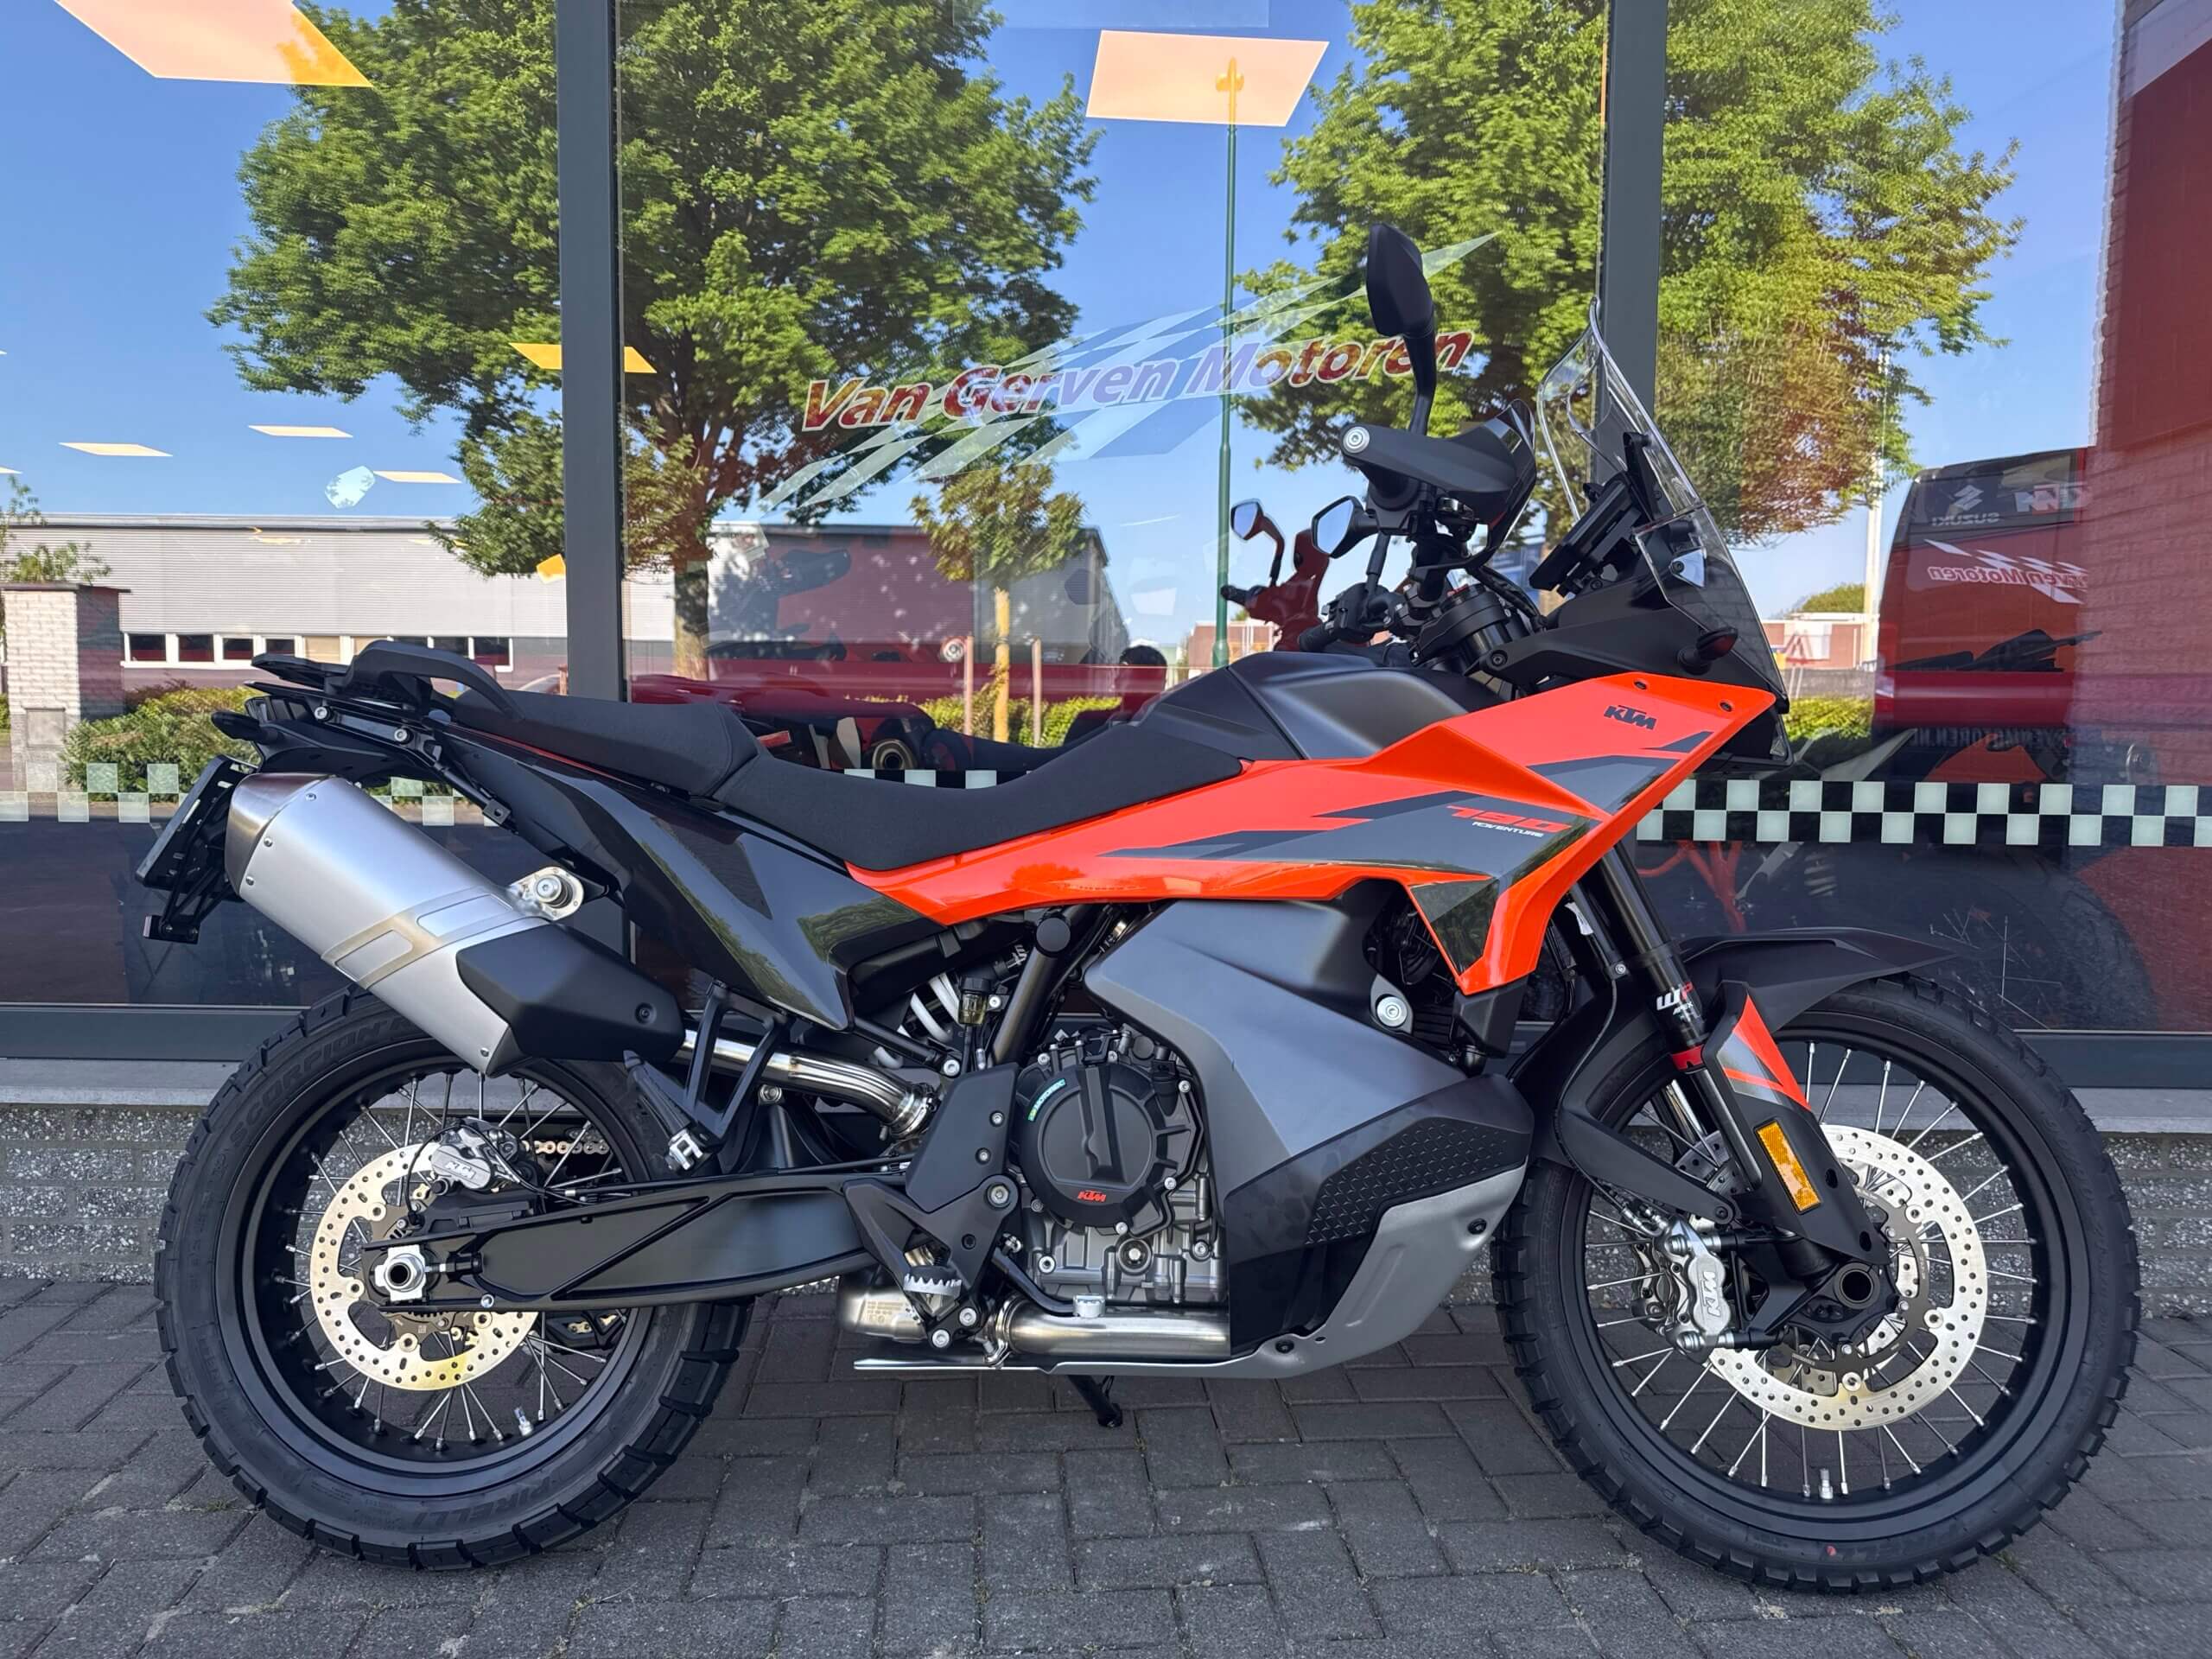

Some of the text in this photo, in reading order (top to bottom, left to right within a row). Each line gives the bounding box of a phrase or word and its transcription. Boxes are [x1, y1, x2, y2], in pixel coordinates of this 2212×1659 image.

[802, 330, 1474, 431] Van Gerven Motoren
[1603, 704, 1657, 730] KTM
[1446, 805, 1572, 833] 790
[1471, 821, 1544, 837] ADVENTURE
[1656, 982, 1694, 1011] WP
[445, 1160, 477, 1180] KTM
[1077, 1189, 1107, 1203] KTM
[1700, 1271, 1723, 1317] KTM
